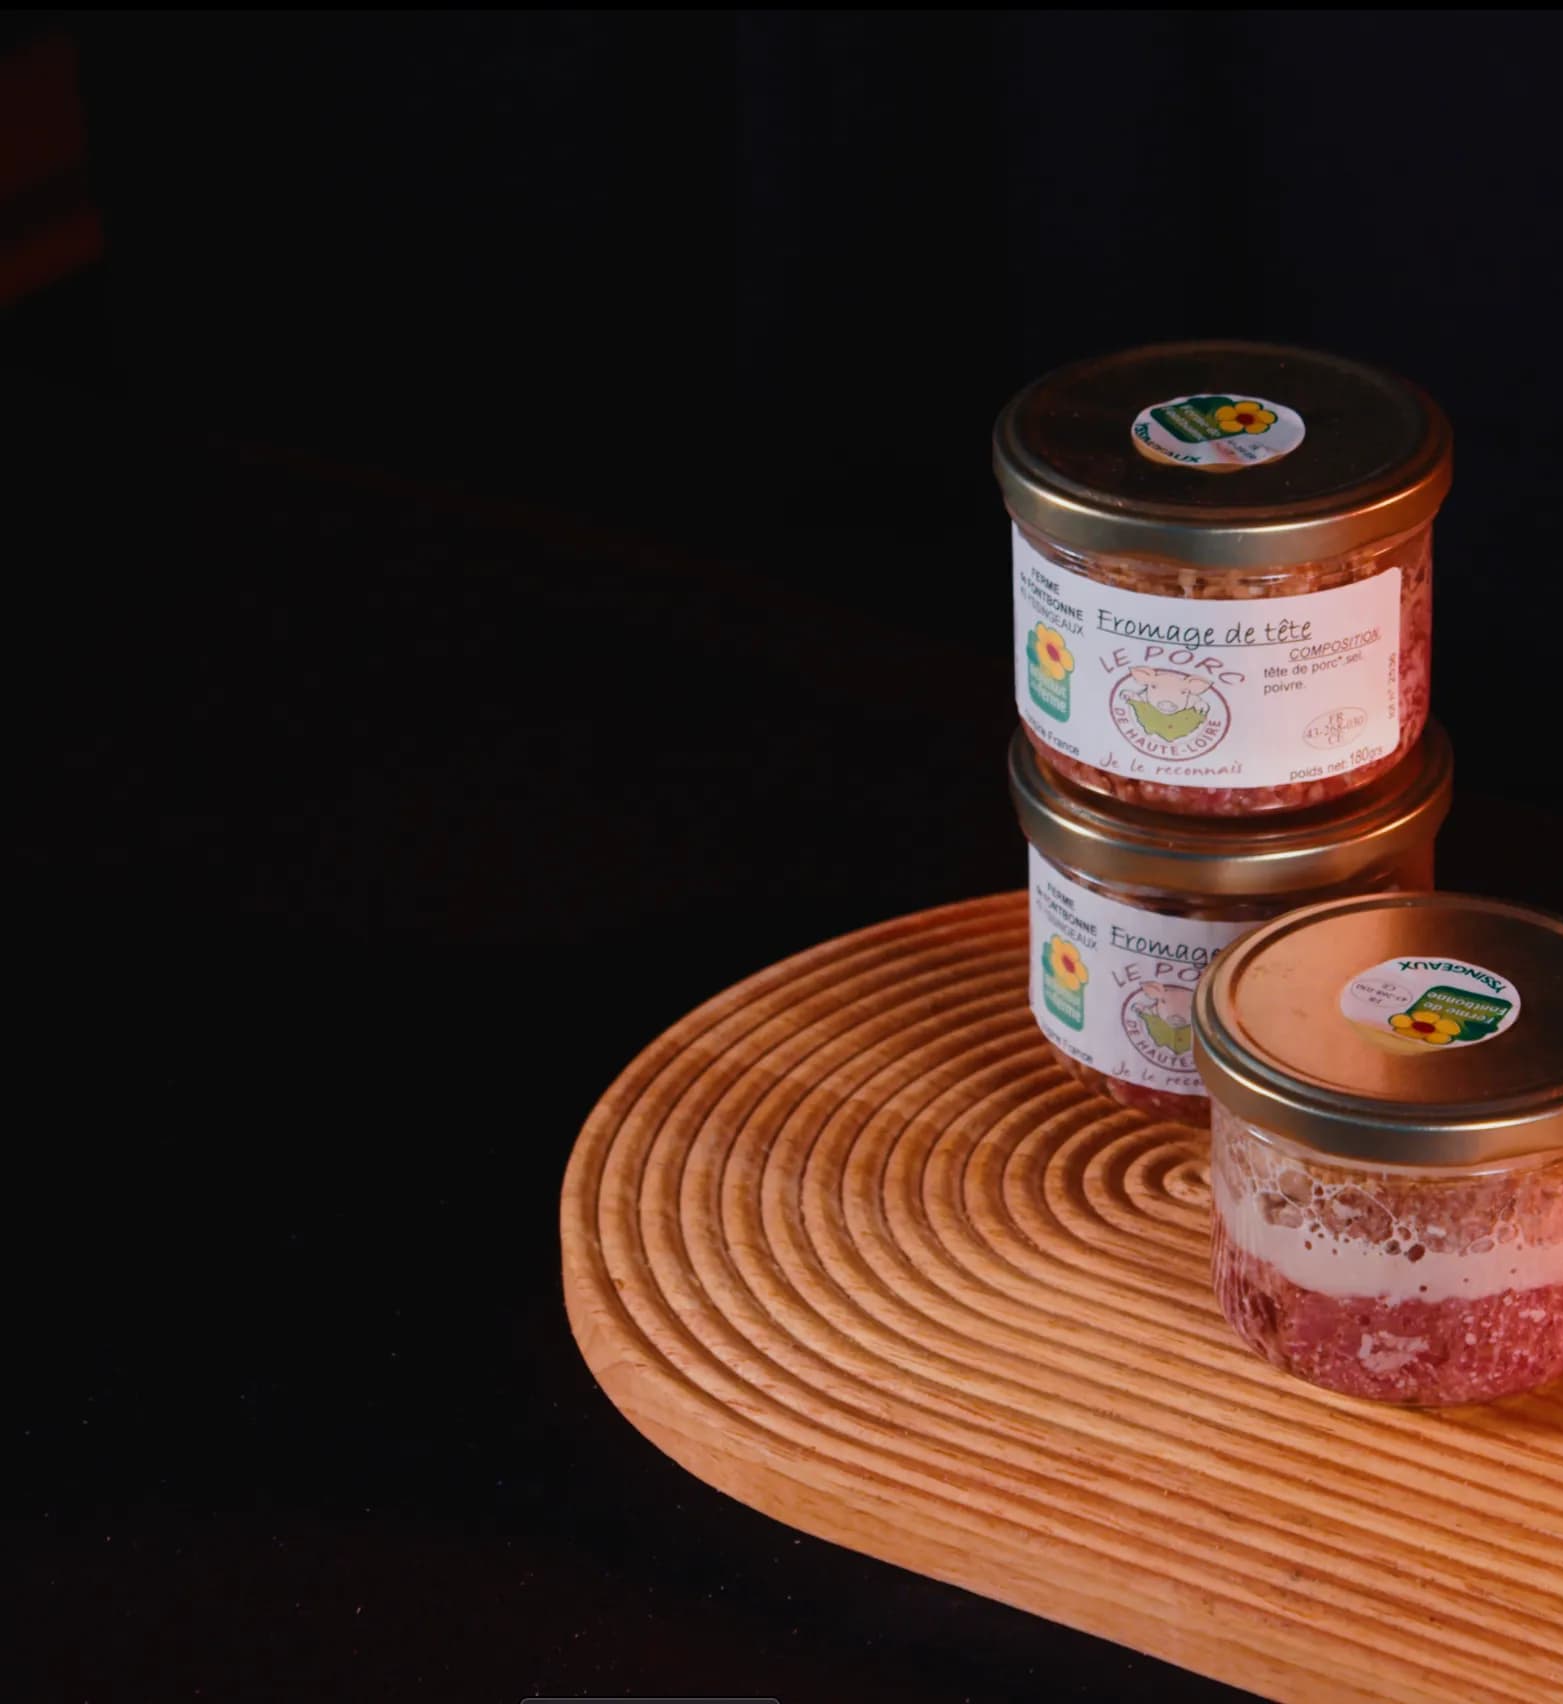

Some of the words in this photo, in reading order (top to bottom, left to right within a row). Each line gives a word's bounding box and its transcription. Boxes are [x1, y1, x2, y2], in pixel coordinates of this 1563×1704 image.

[1096, 608, 1215, 650] Fromage
[1225, 621, 1257, 645] de
[1264, 618, 1312, 643] tête
[1288, 626, 1382, 662] COMPOSITION
[1099, 648, 1131, 674] LE
[1143, 645, 1246, 685] PORC
[1263, 667, 1289, 679] tête
[1291, 664, 1308, 676] de
[1114, 707, 1129, 724] DE
[1125, 719, 1222, 756] HAUTE-LOIRE
[1100, 752, 1120, 769] Je
[1130, 758, 1144, 773] le
[1155, 761, 1243, 777] reconnais
[1290, 767, 1323, 781] poids
[1111, 963, 1141, 988] LE
[1398, 960, 1507, 994] YSSINGEAUX
[1424, 1001, 1444, 1013] de
[1446, 1007, 1495, 1025] Ferme
